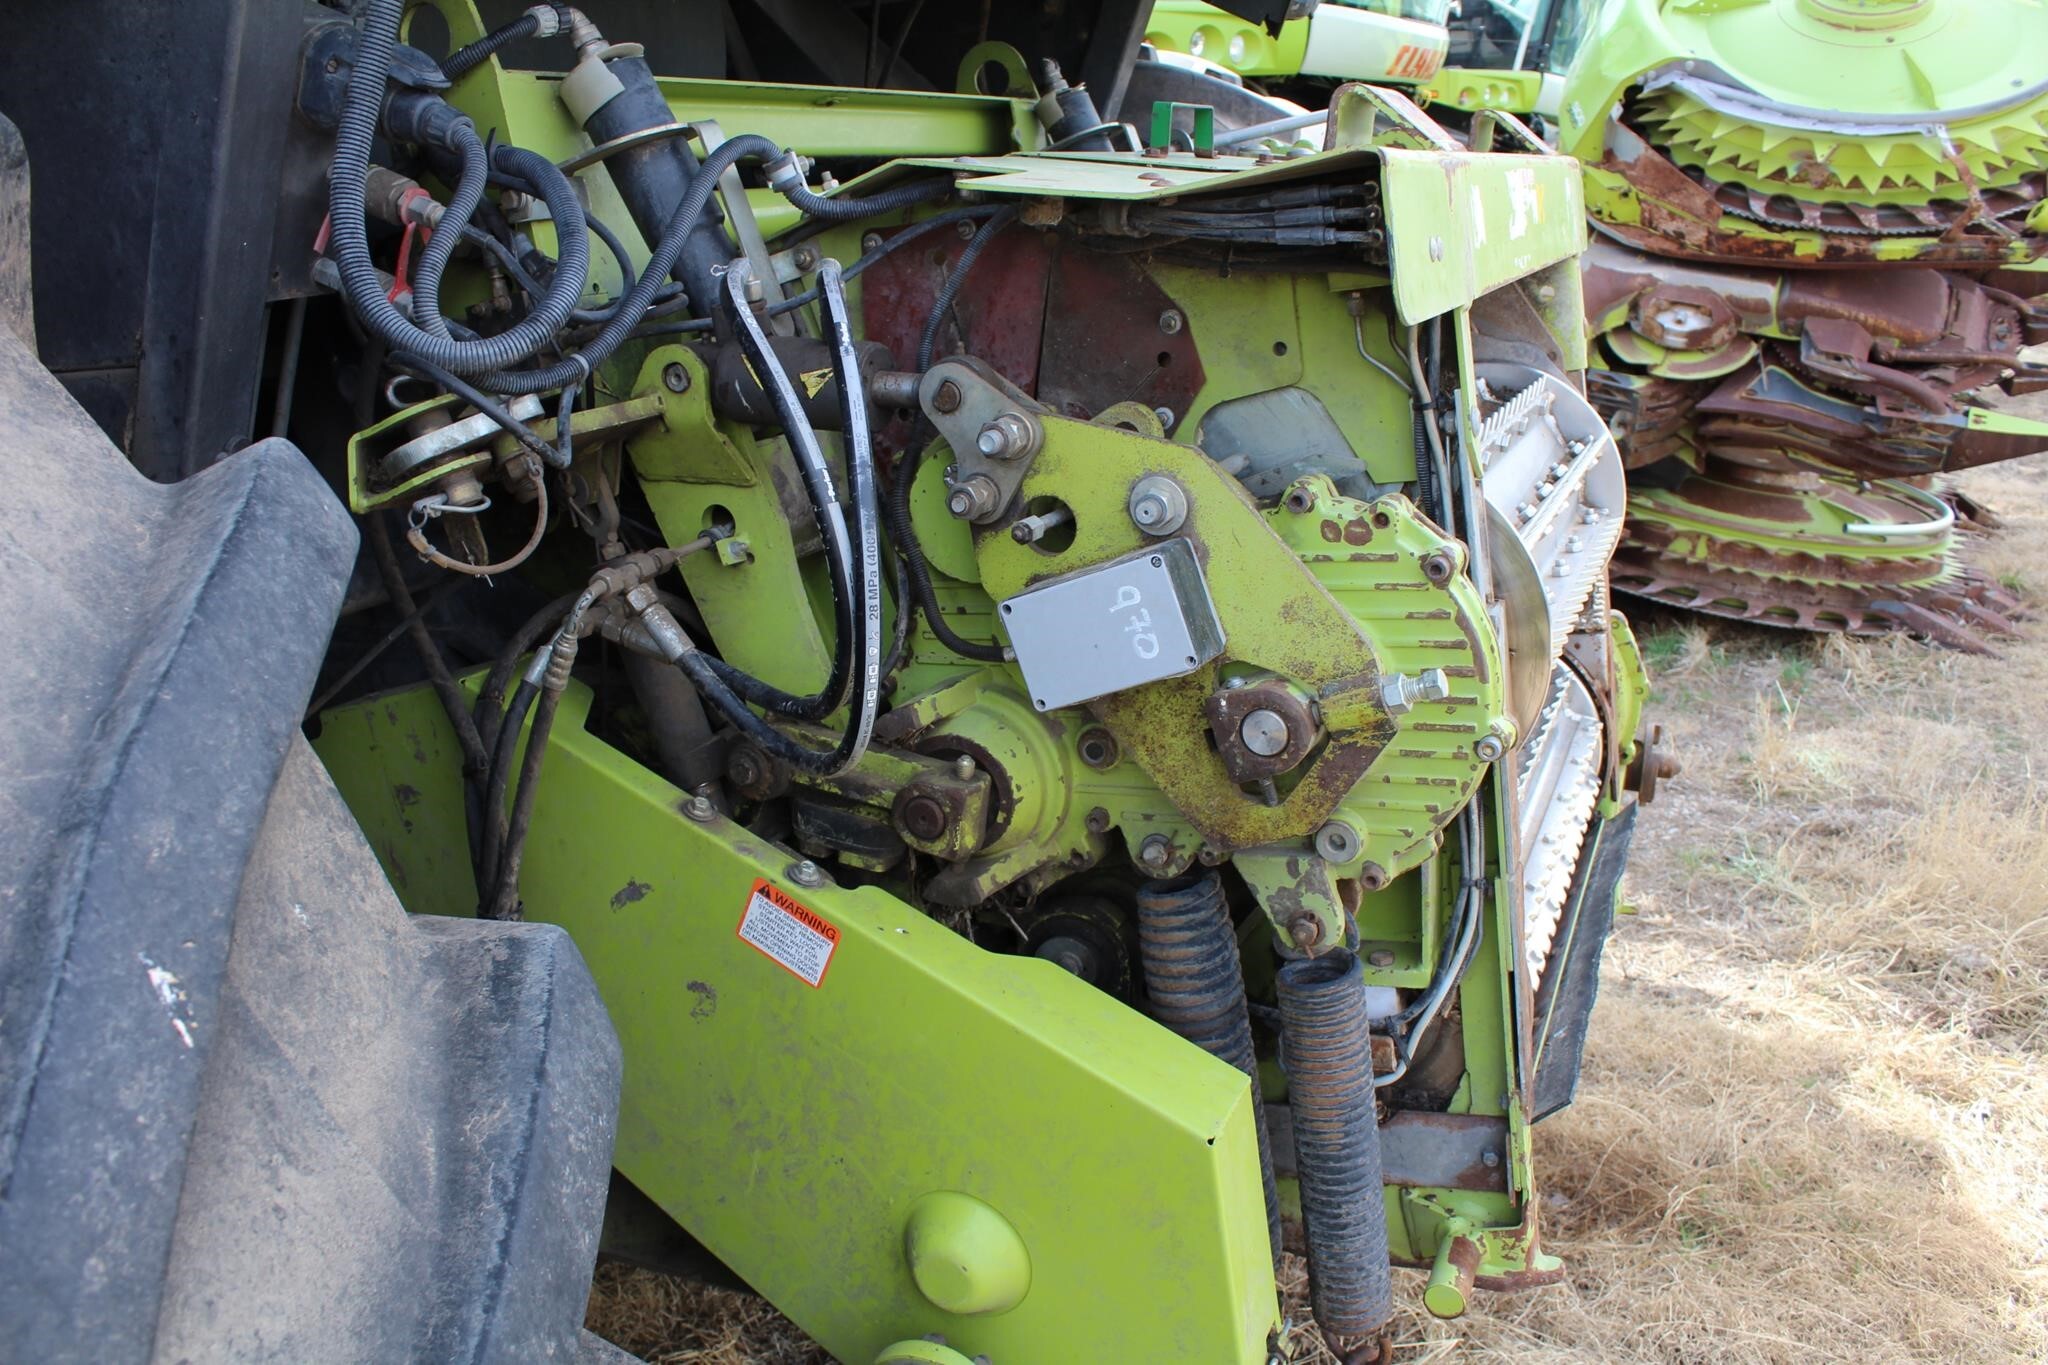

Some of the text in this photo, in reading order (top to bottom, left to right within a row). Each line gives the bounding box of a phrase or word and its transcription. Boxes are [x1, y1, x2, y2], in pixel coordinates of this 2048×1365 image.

[867, 569, 879, 600] MPa
[868, 604, 879, 620] 28
[755, 894, 764, 903] TO
[763, 900, 782, 915] AVOID
[757, 902, 773, 916] STOP
[775, 891, 836, 940] WARNING
[748, 918, 819, 968] ALL MOVEMENT TO STOP
[751, 933, 775, 952] MAKING
[755, 915, 817, 960] LISTEN AND WAIT FOR
[769, 939, 796, 960] OPENING
[796, 957, 818, 974] DOORS
